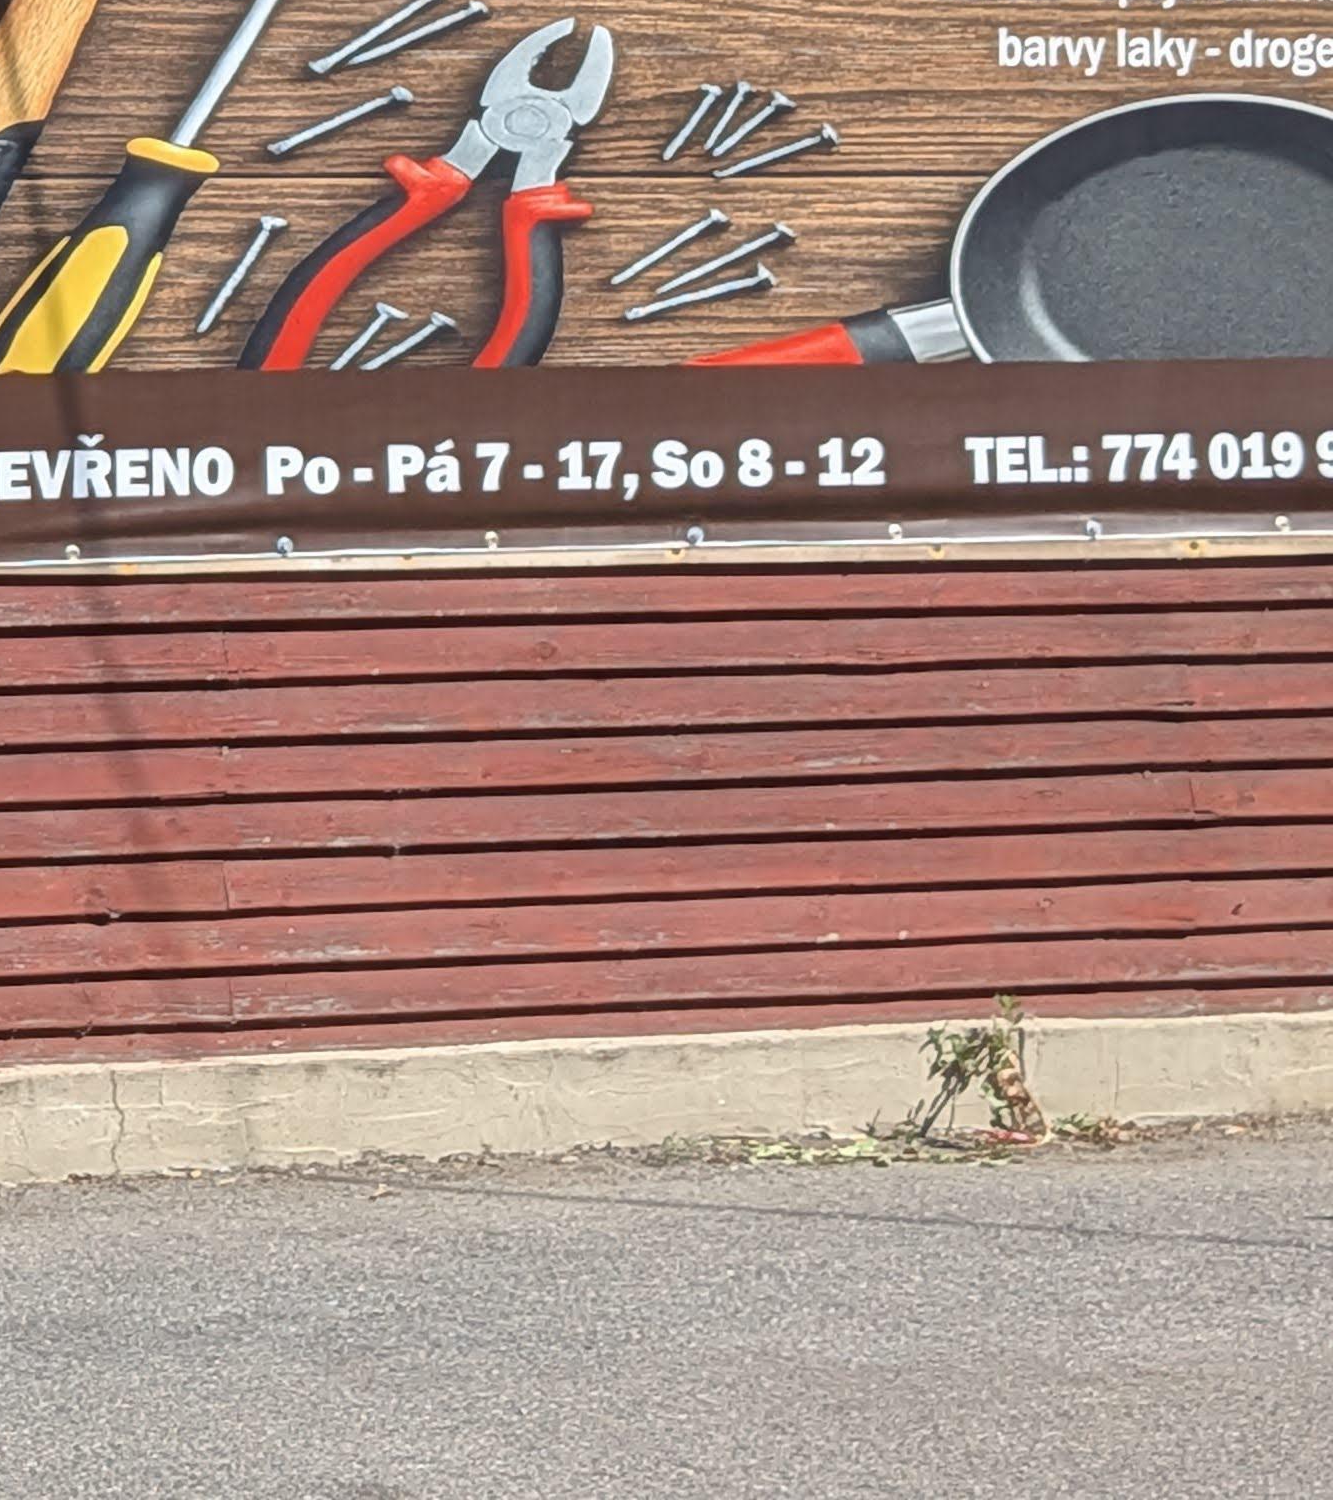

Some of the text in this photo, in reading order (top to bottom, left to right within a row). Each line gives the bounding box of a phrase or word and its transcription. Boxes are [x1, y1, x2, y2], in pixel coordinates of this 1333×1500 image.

[997, 27, 1104, 79] barvy
[1115, 27, 1200, 79] laky
[264, 445, 341, 496] Po
[386, 437, 461, 494] Pá
[474, 440, 511, 492] 7
[555, 438, 640, 501] 17,
[650, 438, 725, 490] So
[737, 438, 774, 488] 8
[817, 435, 887, 487] 12
[1100, 432, 1198, 483] 774
[1207, 430, 1305, 481] 019
